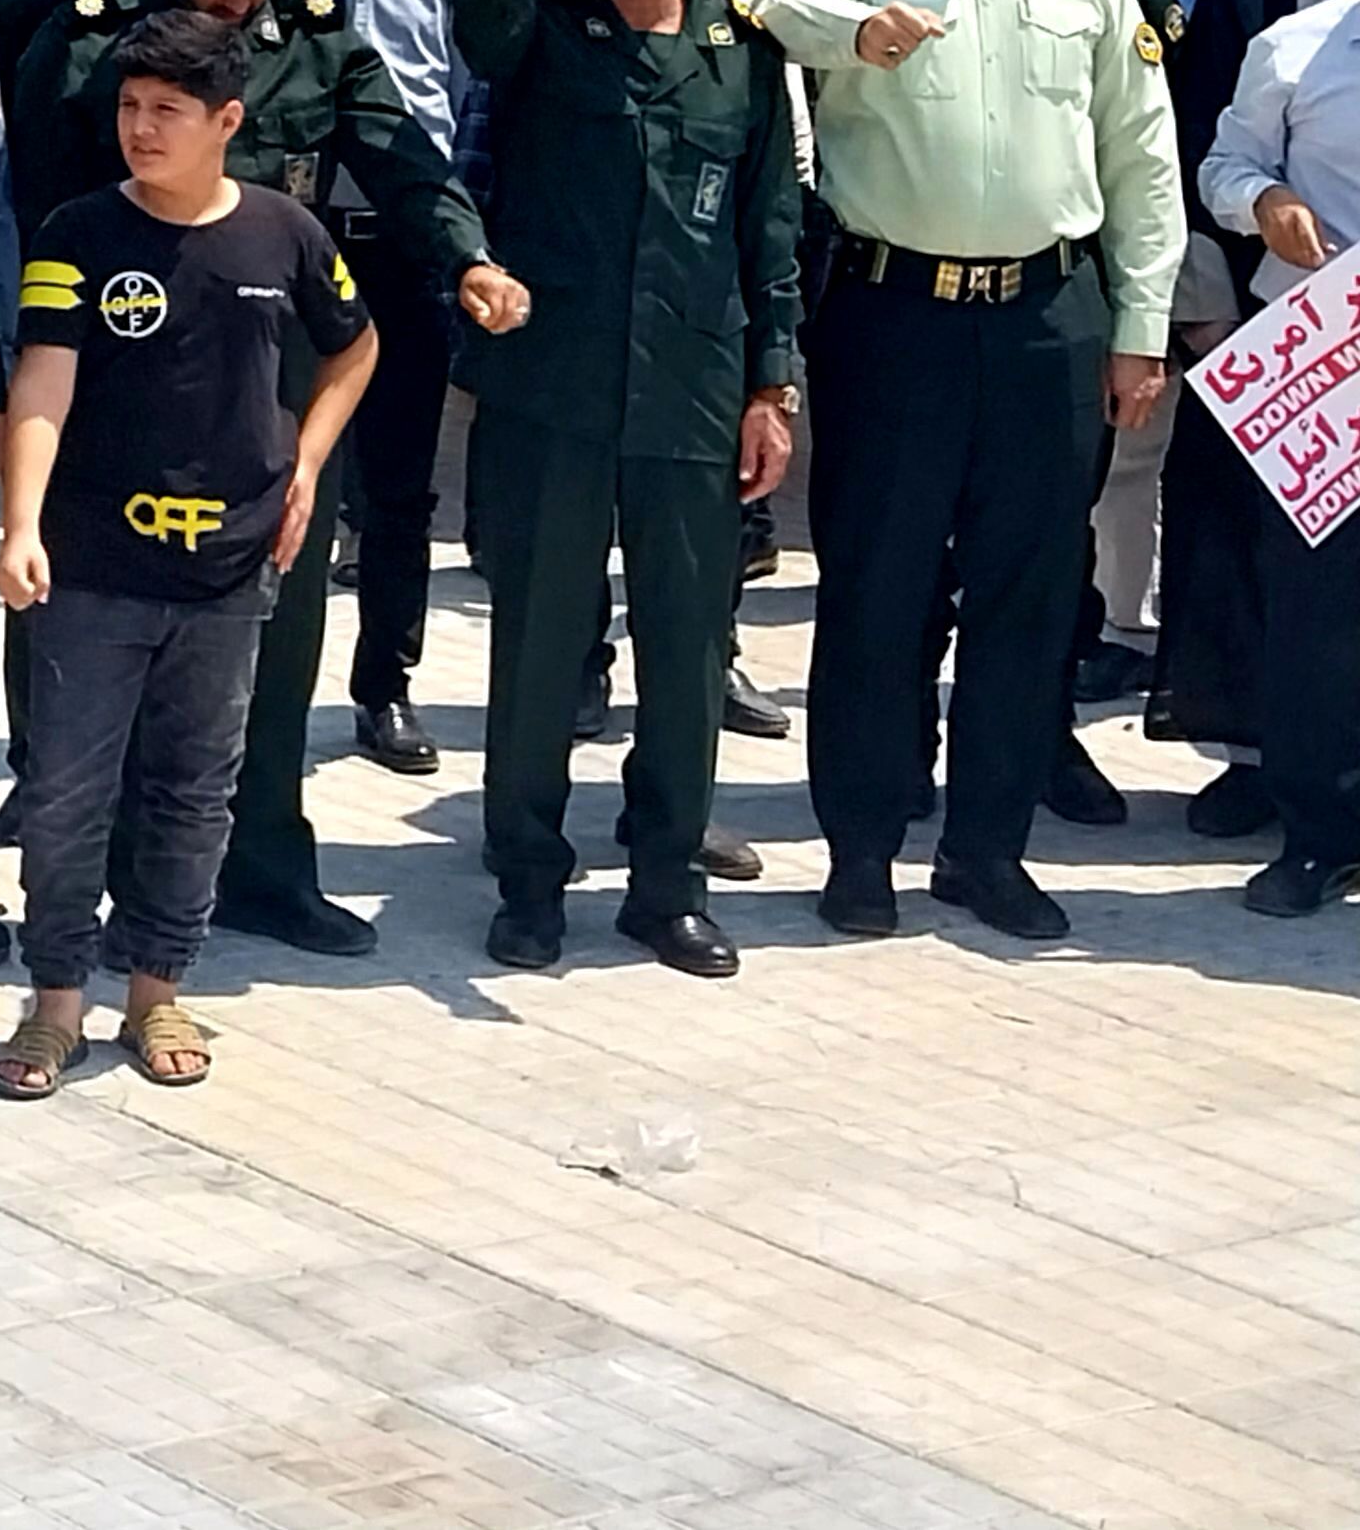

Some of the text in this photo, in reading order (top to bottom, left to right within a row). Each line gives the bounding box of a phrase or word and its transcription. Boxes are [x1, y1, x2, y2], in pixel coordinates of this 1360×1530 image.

[1204, 285, 1323, 404] آمریکا
[1243, 365, 1335, 446] DOWN
[124, 493, 226, 552] OFF
